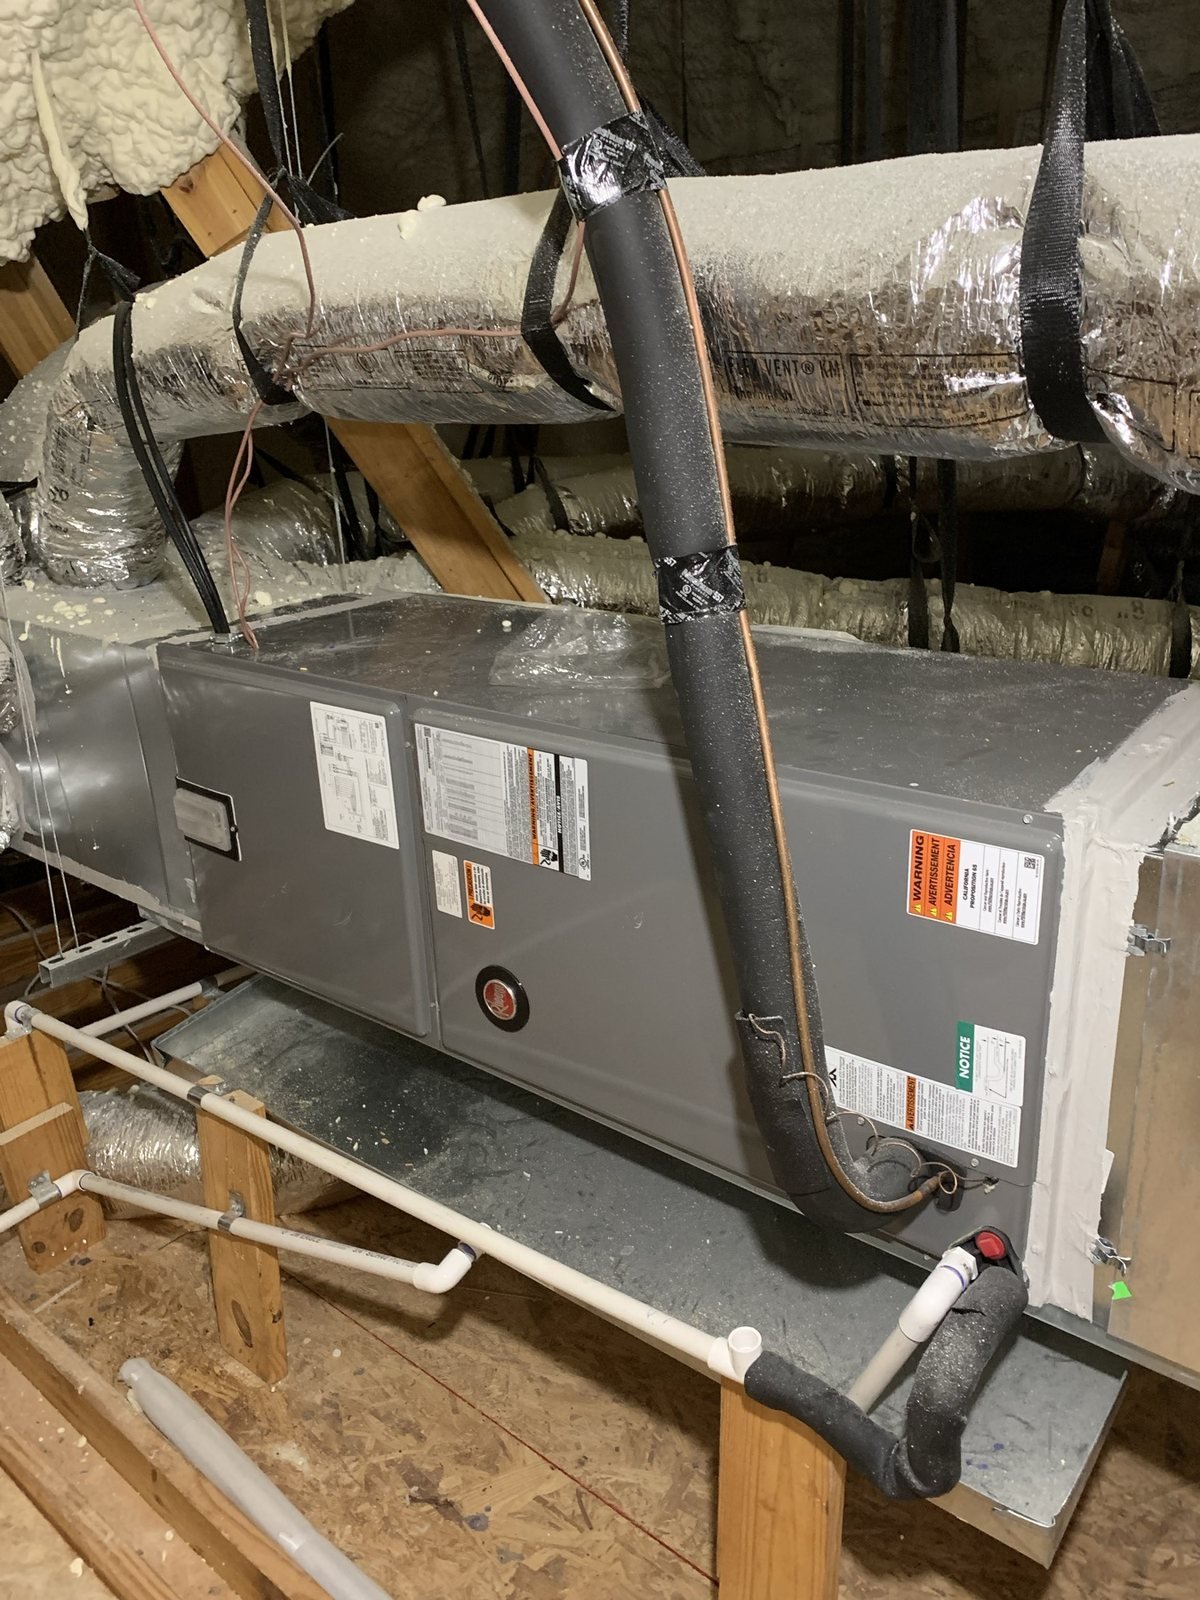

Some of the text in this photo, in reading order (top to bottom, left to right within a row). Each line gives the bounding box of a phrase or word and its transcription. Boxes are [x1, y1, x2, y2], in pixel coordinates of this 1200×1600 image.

[529, 753, 537, 840] WARNING/AVERTISSEMENT
[913, 836, 924, 901] WARNING
[928, 838, 940, 906] AVERTISSEMENT
[944, 844, 956, 906] ADVERTENCIA
[960, 1036, 971, 1079] NOTICE
[907, 1076, 916, 1123] AVERTISSEMENT
